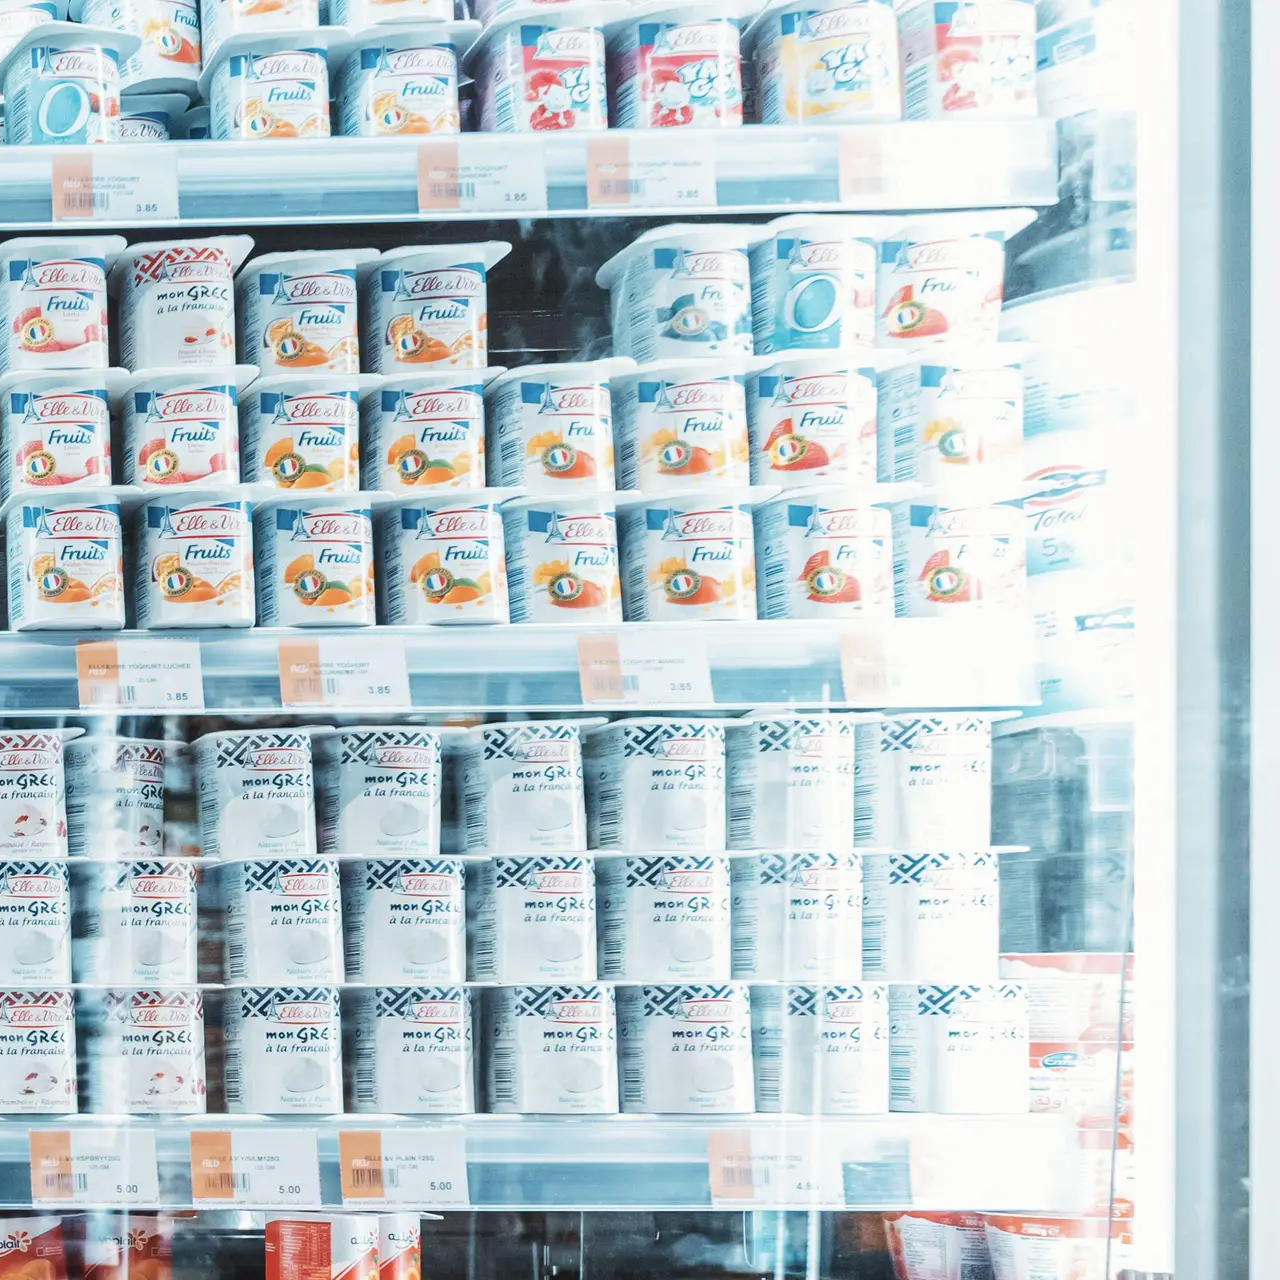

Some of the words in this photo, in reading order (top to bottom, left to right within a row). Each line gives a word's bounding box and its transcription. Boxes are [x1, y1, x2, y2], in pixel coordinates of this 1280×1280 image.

[268, 85, 311, 102] Fruits
[136, 203, 158, 212] 3.85
[157, 289, 183, 302] mon
[173, 427, 216, 443] Fruits
[60, 546, 104, 561] Fruits
[368, 686, 390, 694] 3.85
[166, 693, 188, 701] 3.85
[364, 773, 391, 786] mon
[116, 1185, 139, 1194] 5.00
[279, 1186, 301, 1194] 5.00
[430, 1182, 452, 1191] 5.00
